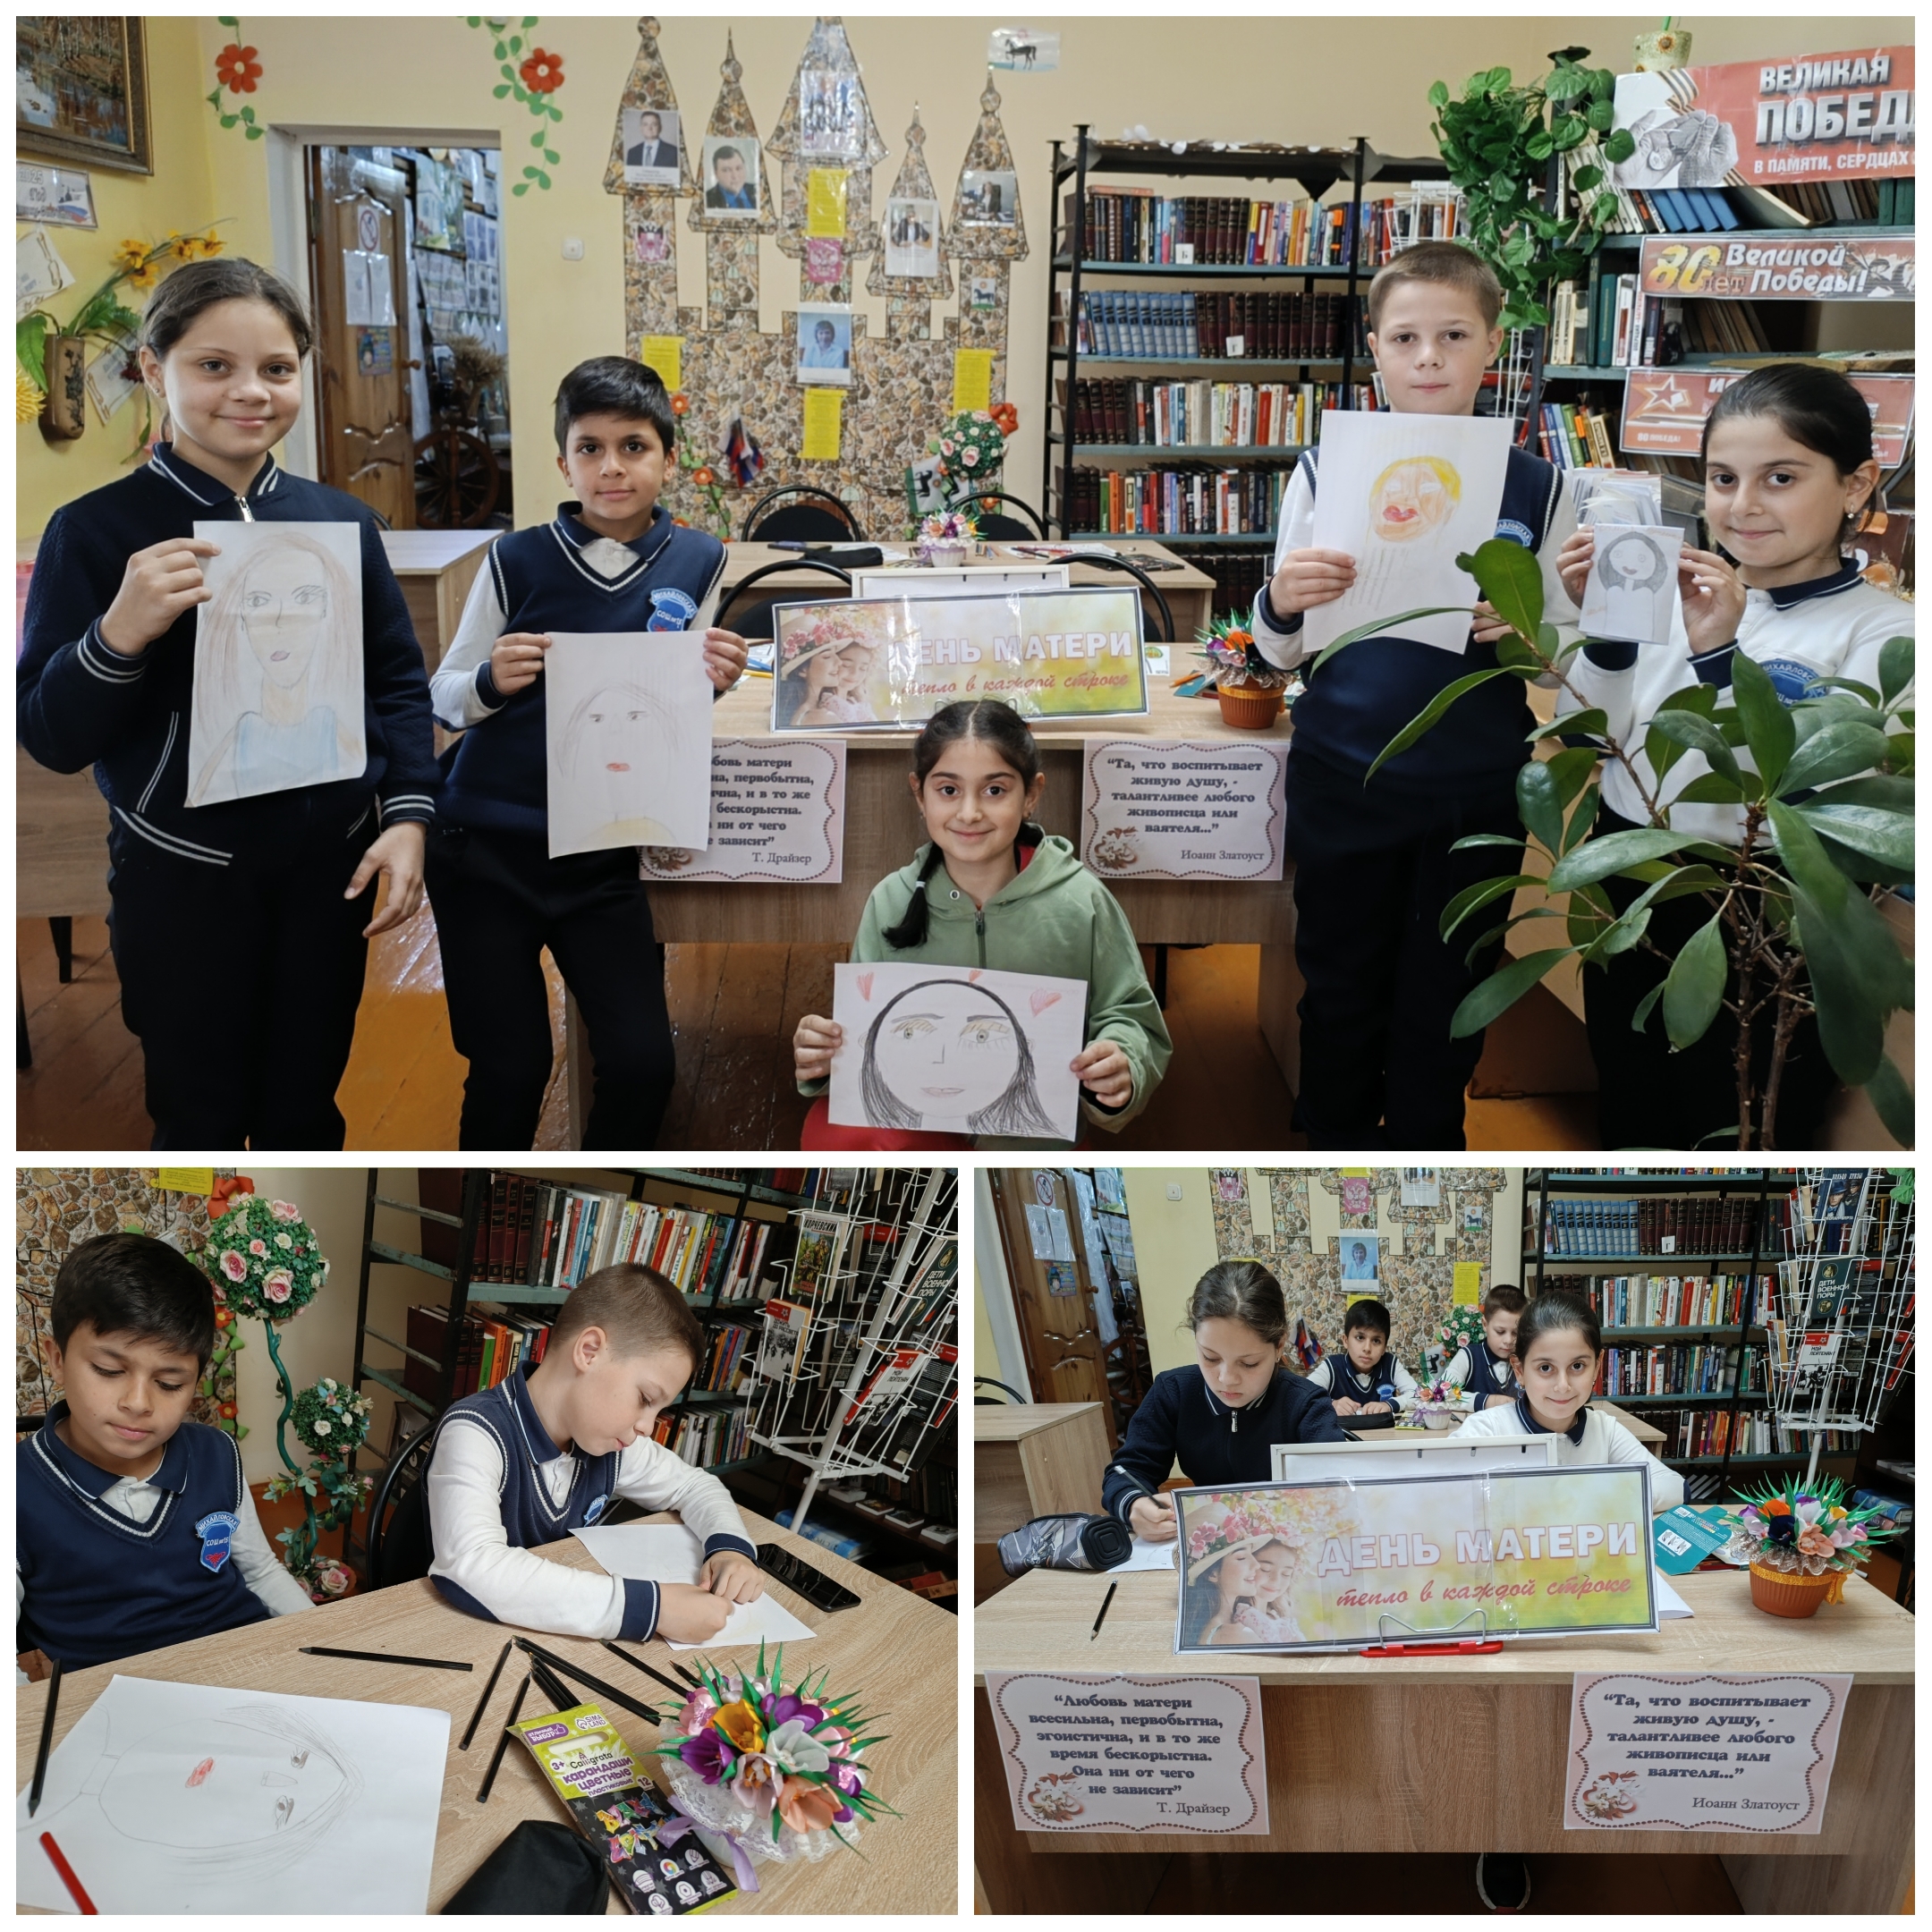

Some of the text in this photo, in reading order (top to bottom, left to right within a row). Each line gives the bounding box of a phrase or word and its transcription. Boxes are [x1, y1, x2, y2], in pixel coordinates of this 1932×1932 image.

[1758, 55, 1890, 94] ВЕЛИКАЯ
[1754, 150, 1910, 174] В ПАМЯТИ, СЕРДЦАХ
[1724, 242, 1847, 268] Великой
[1699, 275, 1745, 293] лет
[1750, 268, 1868, 294] Победы!
[993, 631, 1132, 662] МАТЕРИ
[965, 674, 977, 691] в
[1063, 672, 1130, 693] строке
[746, 758, 792, 769] матери
[1141, 761, 1165, 770] что
[1172, 761, 1263, 772] воспитывает
[733, 772, 814, 786] первобытна,
[1131, 776, 1181, 788] живую
[1185, 776, 1228, 789] душу,
[746, 791, 755, 799] и
[772, 791, 787, 799] то
[792, 792, 811, 801] же
[1111, 791, 1256, 802] талантливее любого
[716, 803, 802, 816] бескорыстна.
[1127, 808, 1239, 818] живописца или
[717, 820, 786, 832] ни от чего
[751, 852, 812, 866] Т. Драйзер
[1181, 850, 1265, 863] Иоанн Златоуст
[928, 1270, 944, 1279] ДЕТИ
[1818, 1279, 1835, 1287] ДЕТИ
[917, 1288, 936, 1297] ПОРЫ
[1817, 1291, 1836, 1299] ПОРЫ
[199, 1513, 238, 1531] МИХАЙЛОВСКАЯ
[1317, 1532, 1442, 1579] ДЕНЬ
[1454, 1521, 1638, 1564] МАТЕРИ
[1336, 1575, 1631, 1608] тепло в каждой строке
[1054, 1694, 1192, 1711] “Любовь матери
[1604, 1693, 1810, 1708] “Та, что воспитывает
[586, 1714, 603, 1724] SIMA
[589, 1718, 607, 1728] LAND
[1029, 1713, 1224, 1728] всесильна, первобытна,
[1633, 1715, 1699, 1727] живую
[1706, 1715, 1761, 1728] душу,
[1037, 1731, 1221, 1745] эгоистична, и в то же
[1606, 1729, 1796, 1744] талантливее любого
[570, 1751, 614, 1769] Calligrata
[1050, 1746, 1213, 1762] время бескорыстна.
[1626, 1749, 1771, 1763] живописца или
[551, 1759, 565, 1771] 3+
[563, 1757, 633, 1784] карандаши
[578, 1767, 632, 1791] цветные
[1072, 1765, 1195, 1780] Она ни от чего
[588, 1777, 633, 1797] пластиковые
[639, 1776, 651, 1787] 12
[1088, 1784, 1182, 1796] не зависит”
[1157, 1801, 1231, 1818] Т. Драйзер
[1691, 1797, 1801, 1812] Иоанн Златоуст
